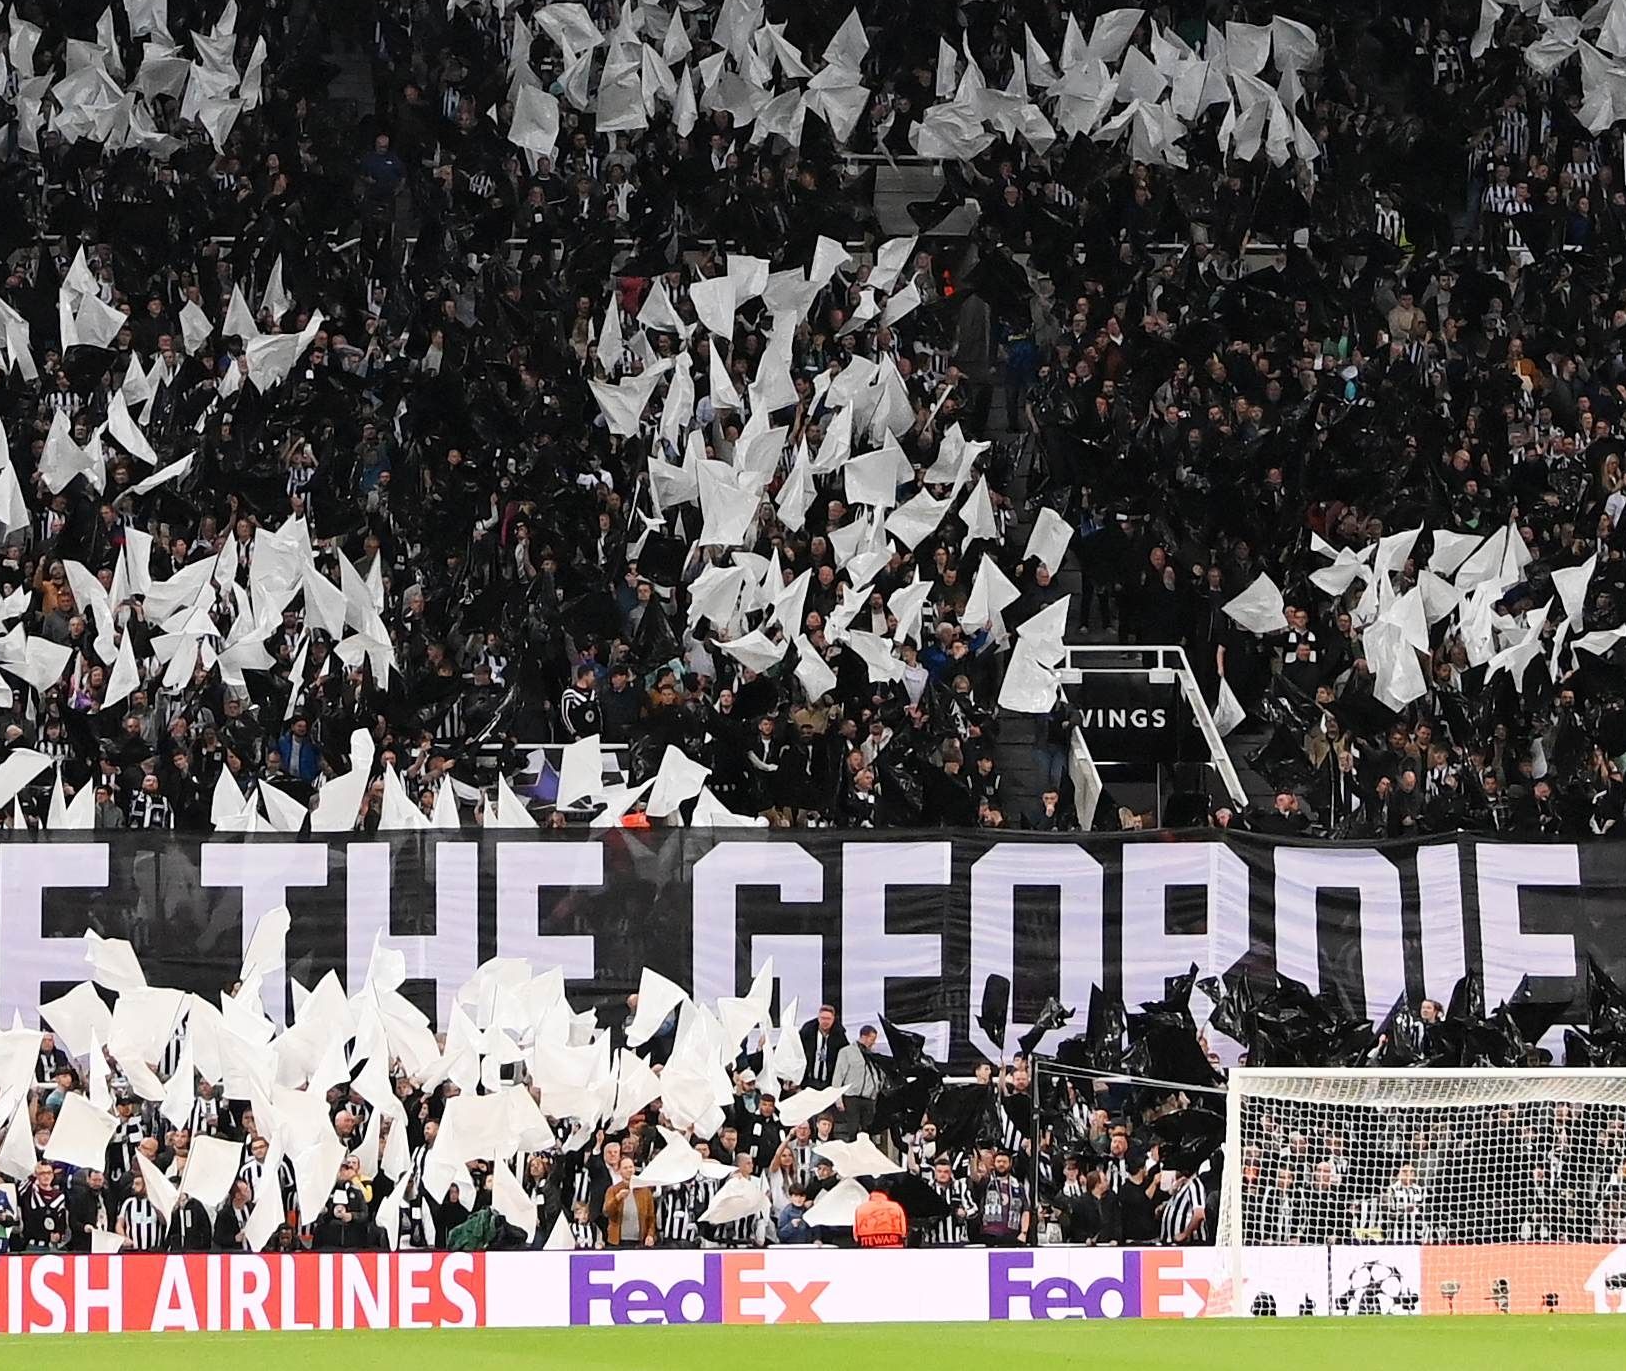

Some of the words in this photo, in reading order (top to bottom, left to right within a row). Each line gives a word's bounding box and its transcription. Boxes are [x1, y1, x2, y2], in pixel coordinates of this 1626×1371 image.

[202, 842, 605, 1038] THE
[692, 840, 1584, 1062] GEORDIE
[153, 1252, 480, 1331] AIRLINES
[569, 1253, 829, 1327] FedEx
